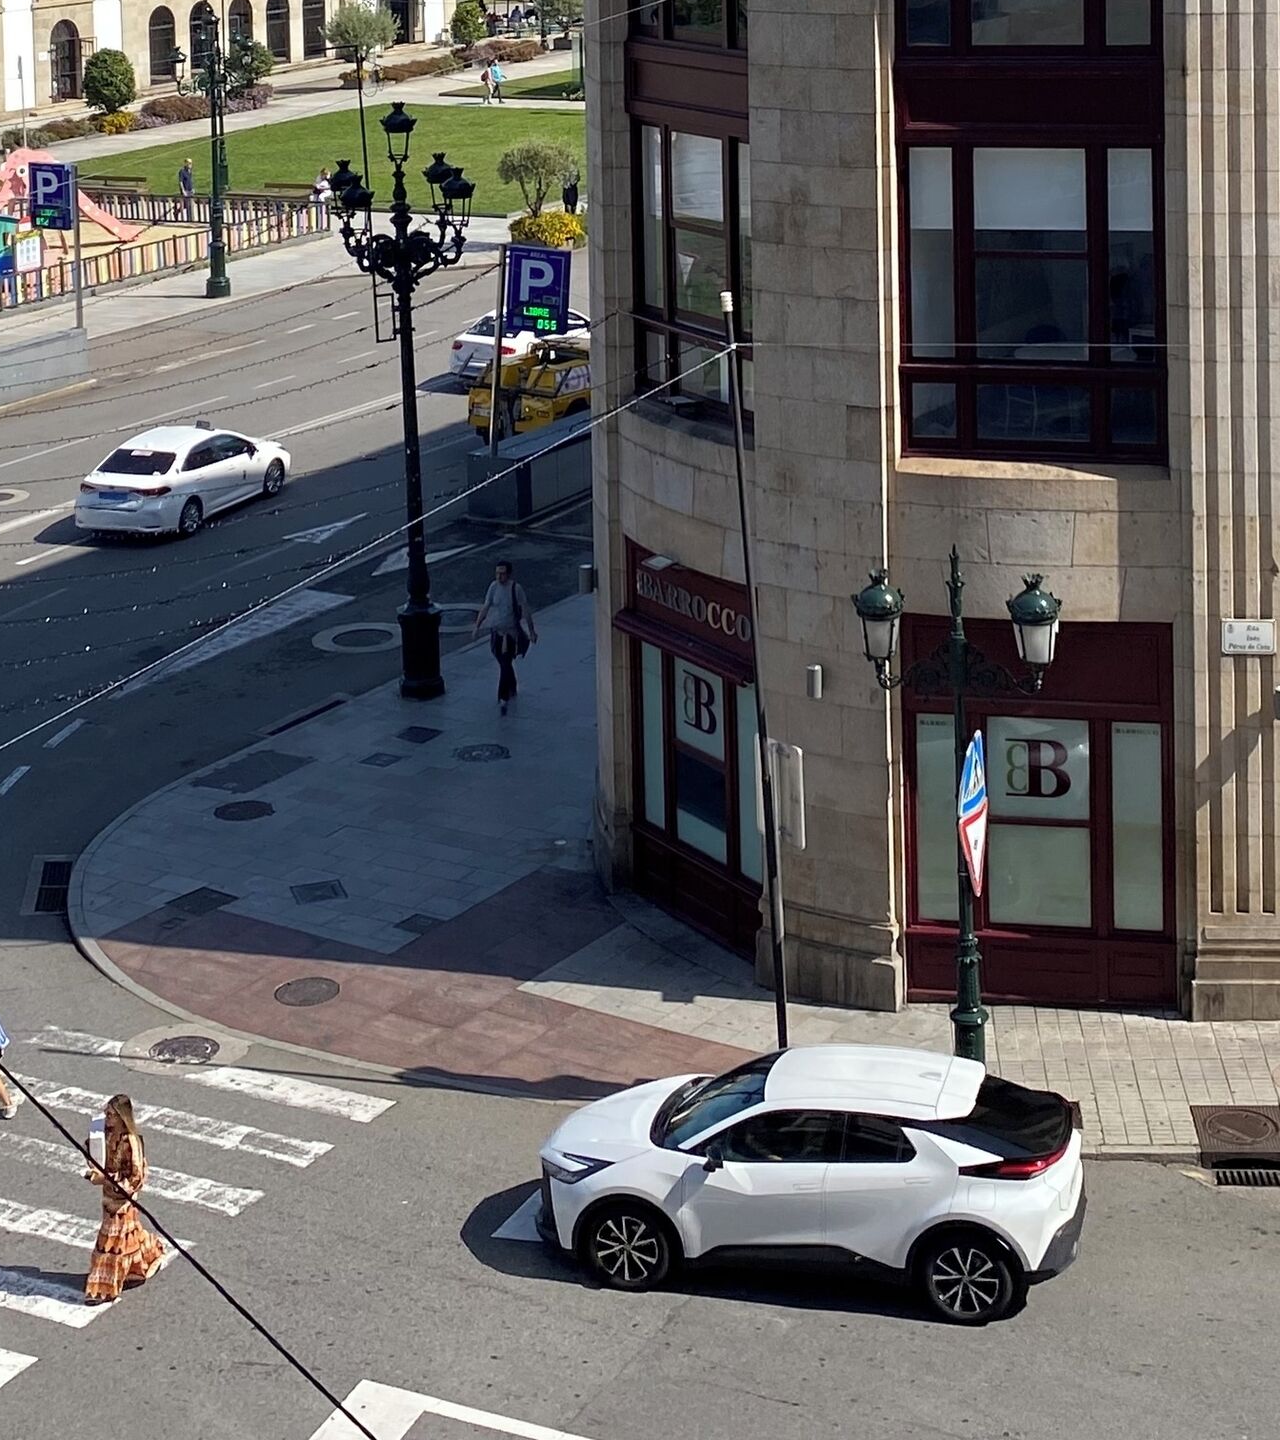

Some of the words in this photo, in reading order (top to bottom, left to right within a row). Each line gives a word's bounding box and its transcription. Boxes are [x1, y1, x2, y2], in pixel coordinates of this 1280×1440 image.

[36, 170, 58, 205] P
[519, 258, 554, 301] P
[523, 306, 550, 317] LIBRE
[636, 568, 752, 642] BARROCCO
